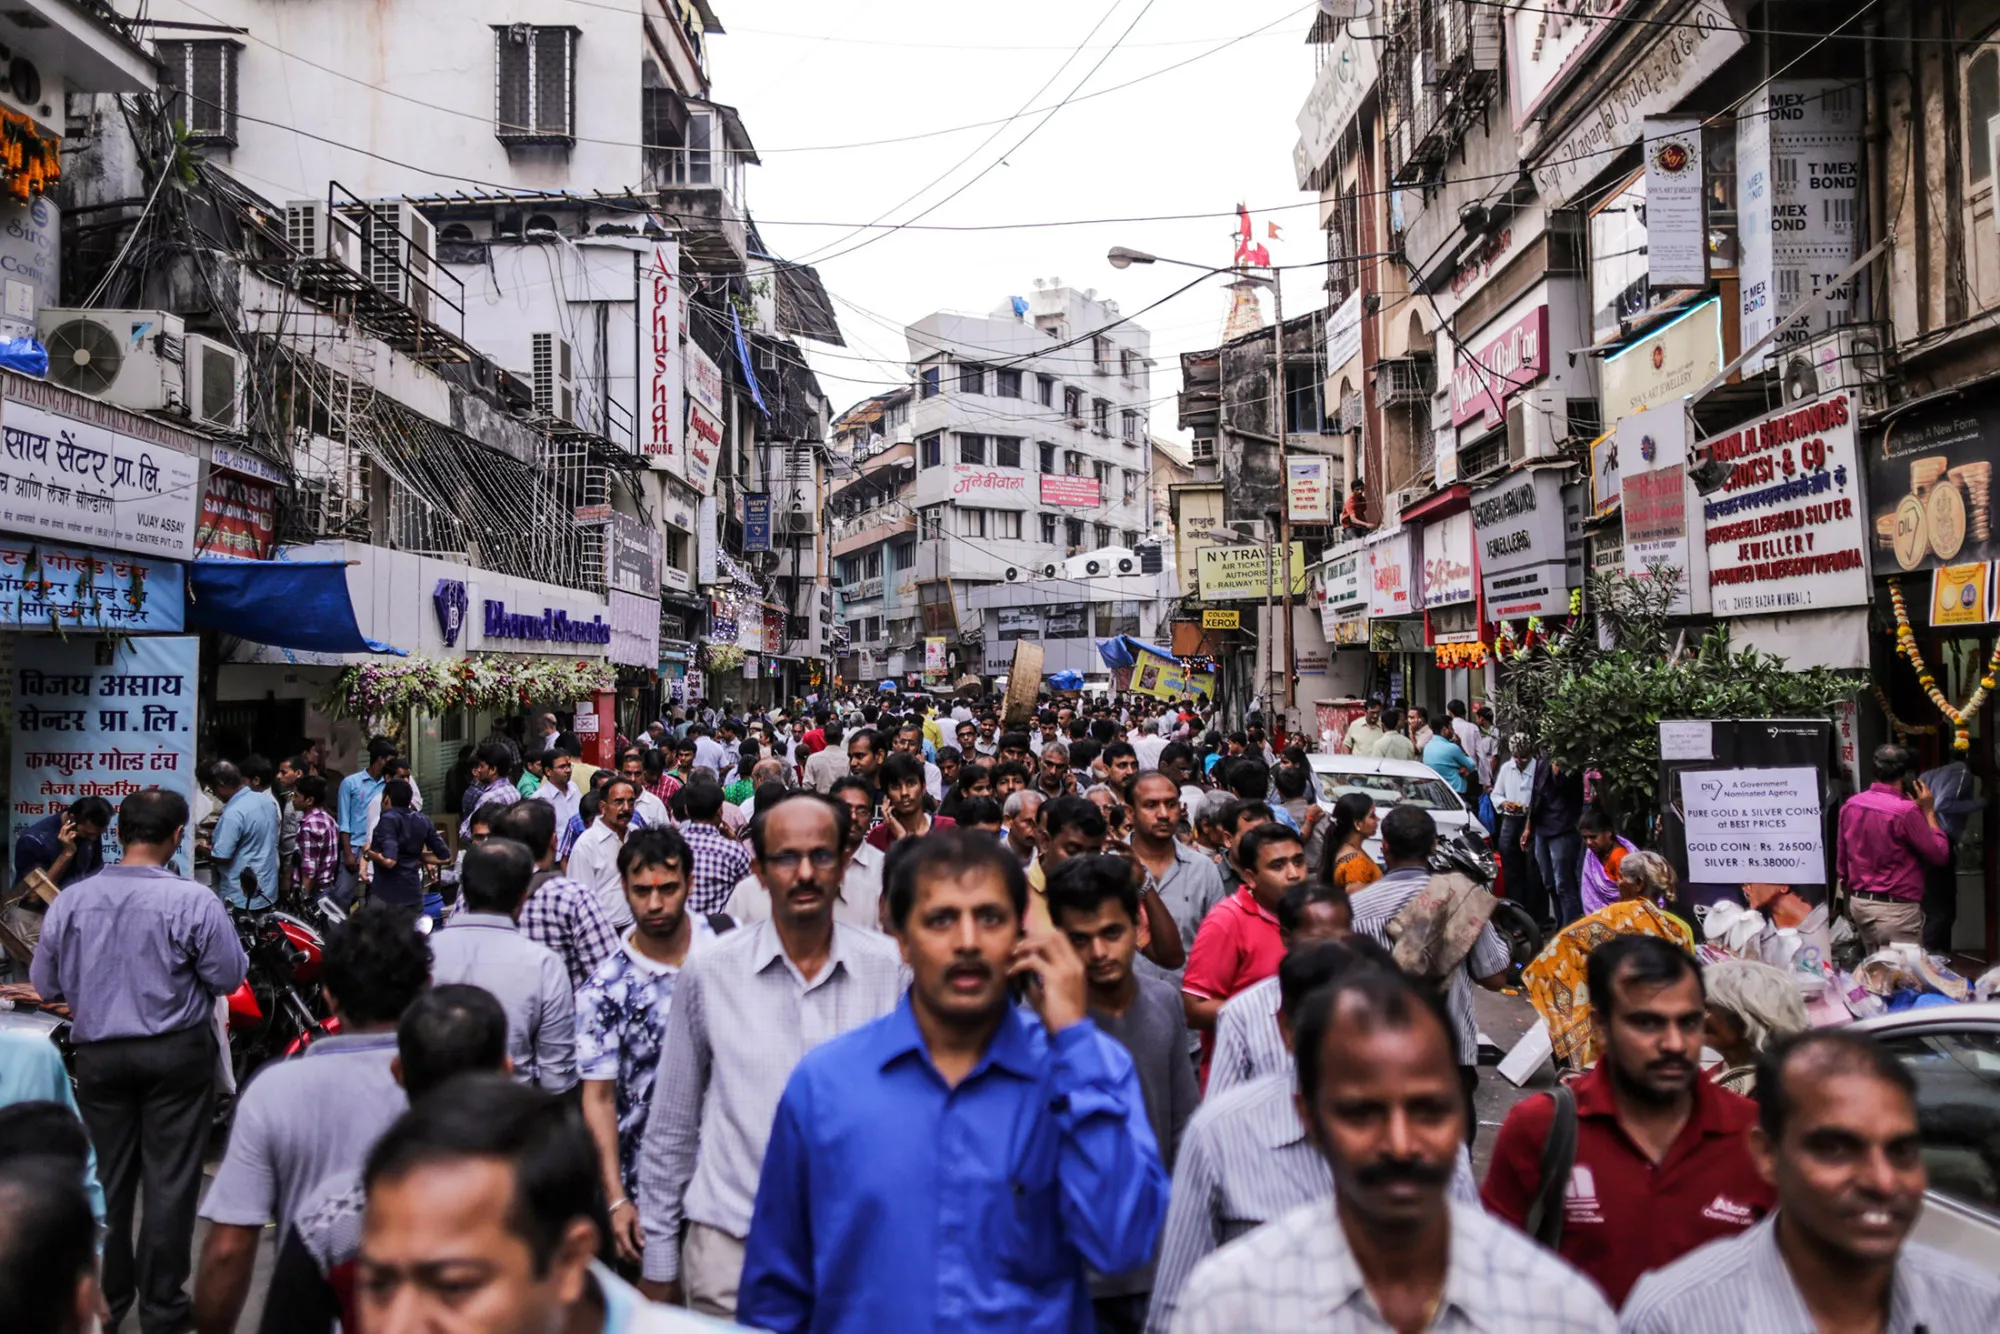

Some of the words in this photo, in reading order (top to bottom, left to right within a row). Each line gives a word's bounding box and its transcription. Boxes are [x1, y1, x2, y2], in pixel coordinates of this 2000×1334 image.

[1810, 177, 1857, 189] BOND
[648, 246, 673, 443] Abhushan
[1492, 326, 1538, 394] Bullon
[1825, 376, 1837, 389] LG
[19, 378, 59, 411] TESTING
[62, 393, 73, 413] OF
[74, 397, 92, 420] ALL
[1926, 428, 1932, 438] A
[1933, 425, 1952, 436] New
[1, 425, 51, 465] साय
[644, 443, 673, 454] HOUSE
[233, 454, 258, 474] USTAD
[954, 471, 1025, 494] जलेबीवाला
[1805, 498, 1853, 525] SILVER
[137, 513, 158, 528] VIJAY
[161, 519, 186, 534] ASSAY
[1898, 515, 1912, 537] DIL
[135, 532, 159, 546] CENTRE
[1187, 529, 1210, 540] ज्वेल
[1486, 529, 1531, 560] JEWELLERS
[1737, 532, 1815, 562] JEWELLERY
[1207, 552, 1217, 562] N
[1219, 551, 1229, 561] Y
[1238, 560, 1281, 569] TICKETG
[1226, 569, 1278, 579] AUTHORISD
[1218, 580, 1253, 589] RAILWAY
[1255, 576, 1299, 586] TICETG
[1205, 619, 1237, 628] XEROX
[988, 660, 1012, 668] KARBA
[19, 669, 92, 697] विजय
[100, 674, 184, 697] असाय
[18, 704, 87, 731] सेन्टर
[99, 747, 146, 770] गोल्ड
[150, 745, 179, 770] टंच
[40, 780, 75, 796] लेजर
[1701, 782, 1716, 792] DIL
[1740, 780, 1788, 788] Government
[1724, 790, 1766, 798] Nominated
[1768, 789, 1798, 798] Agency
[14, 801, 44, 815] गोल्ड
[1688, 809, 1709, 818] PURE
[1711, 809, 1738, 817] GOLD
[1742, 809, 1749, 817] &
[1751, 808, 1783, 816] SILVER
[1717, 820, 1727, 829] at
[1730, 820, 1750, 828] BEST
[1753, 819, 1787, 828] PRICES
[1688, 842, 1717, 852] GOLD
[1721, 842, 1750, 852] COIN
[1760, 843, 1773, 852] Rs.
[1778, 842, 1823, 852] 26500/-
[1705, 858, 1738, 867] SILVER
